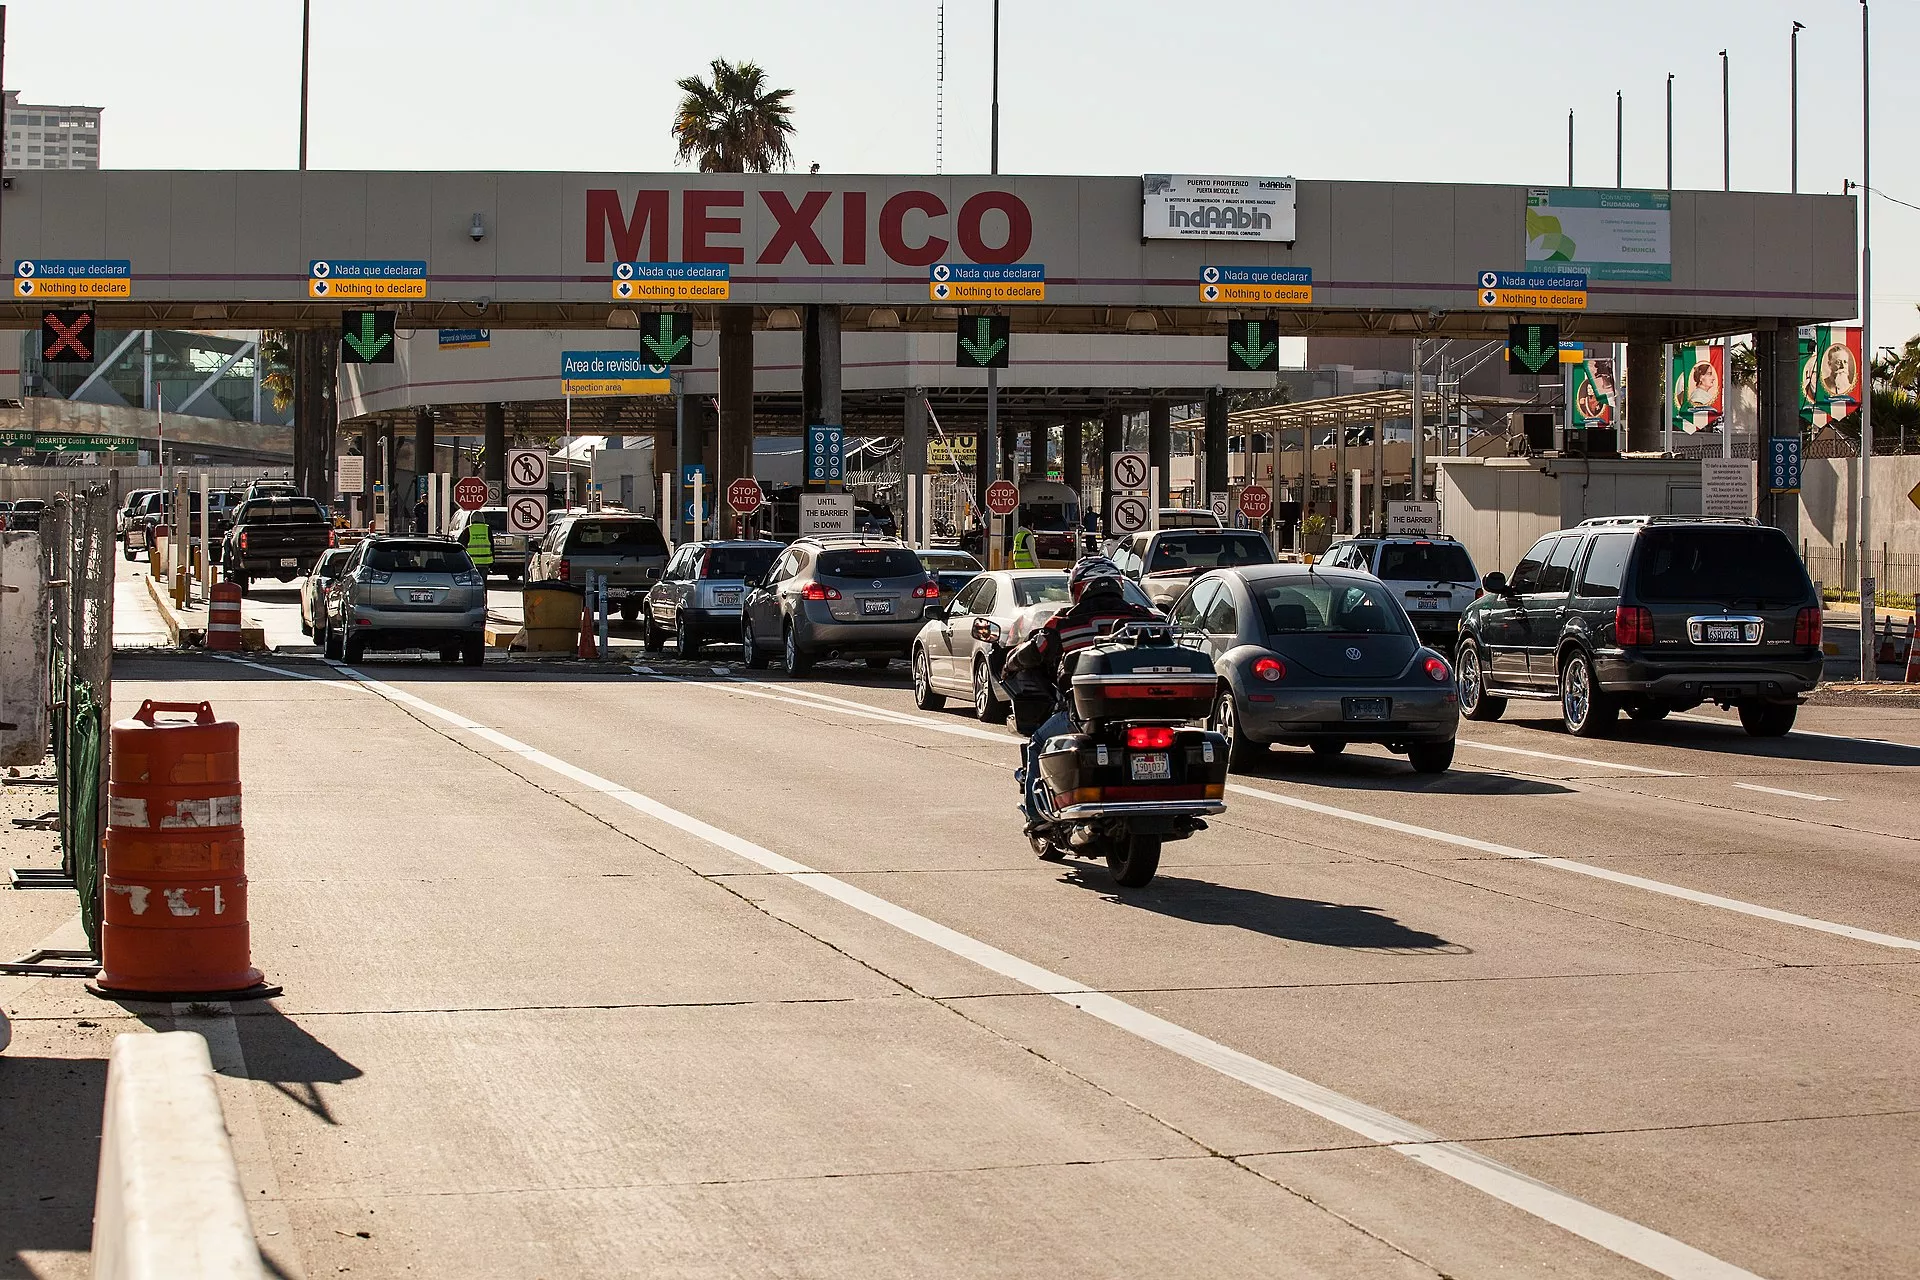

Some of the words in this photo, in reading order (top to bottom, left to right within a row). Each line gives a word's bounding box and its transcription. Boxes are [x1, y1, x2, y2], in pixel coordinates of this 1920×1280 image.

[585, 190, 1033, 267] MEXICO
[40, 264, 64, 274] Nada
[68, 266, 86, 276] que
[88, 264, 127, 274] declarar
[335, 265, 360, 274] Nada
[364, 266, 381, 276] que
[384, 266, 422, 275] declarar
[638, 266, 664, 276] Nada
[666, 268, 684, 278] que
[686, 267, 726, 277] declarar
[955, 268, 980, 278] Nada
[982, 270, 1000, 280] que
[1003, 268, 1041, 278] declarar
[1224, 270, 1249, 280] Nada
[1252, 272, 1268, 282] que
[1271, 272, 1308, 282] declarar
[1502, 276, 1526, 286] Nada
[1528, 278, 1545, 288] que
[1548, 278, 1583, 288] declarar
[40, 282, 76, 294] Nothing
[80, 284, 88, 292] to
[91, 282, 126, 292] declare
[336, 284, 372, 295] Nothing
[376, 284, 384, 293] to
[388, 284, 422, 293] declare
[638, 286, 675, 297] Nothing
[678, 286, 688, 294] to
[690, 286, 726, 295] declare
[956, 286, 992, 298] Nothing
[994, 288, 1004, 296] to
[1006, 286, 1041, 296] declare
[1224, 288, 1260, 300] Nothing
[1263, 290, 1272, 298] to
[1274, 290, 1308, 299] declare
[1502, 294, 1537, 305] Nothing
[1540, 294, 1548, 304] to
[1550, 295, 1584, 304] declare
[564, 358, 588, 372] Area
[590, 357, 604, 372] de
[606, 356, 646, 372] revisión
[458, 486, 484, 494] STOP
[732, 487, 758, 496] STOP
[990, 489, 1015, 497] STOP
[459, 494, 484, 502] ALTO
[732, 496, 758, 504] ALTO
[990, 498, 1015, 506] ALTO
[1243, 493, 1267, 501] STOP
